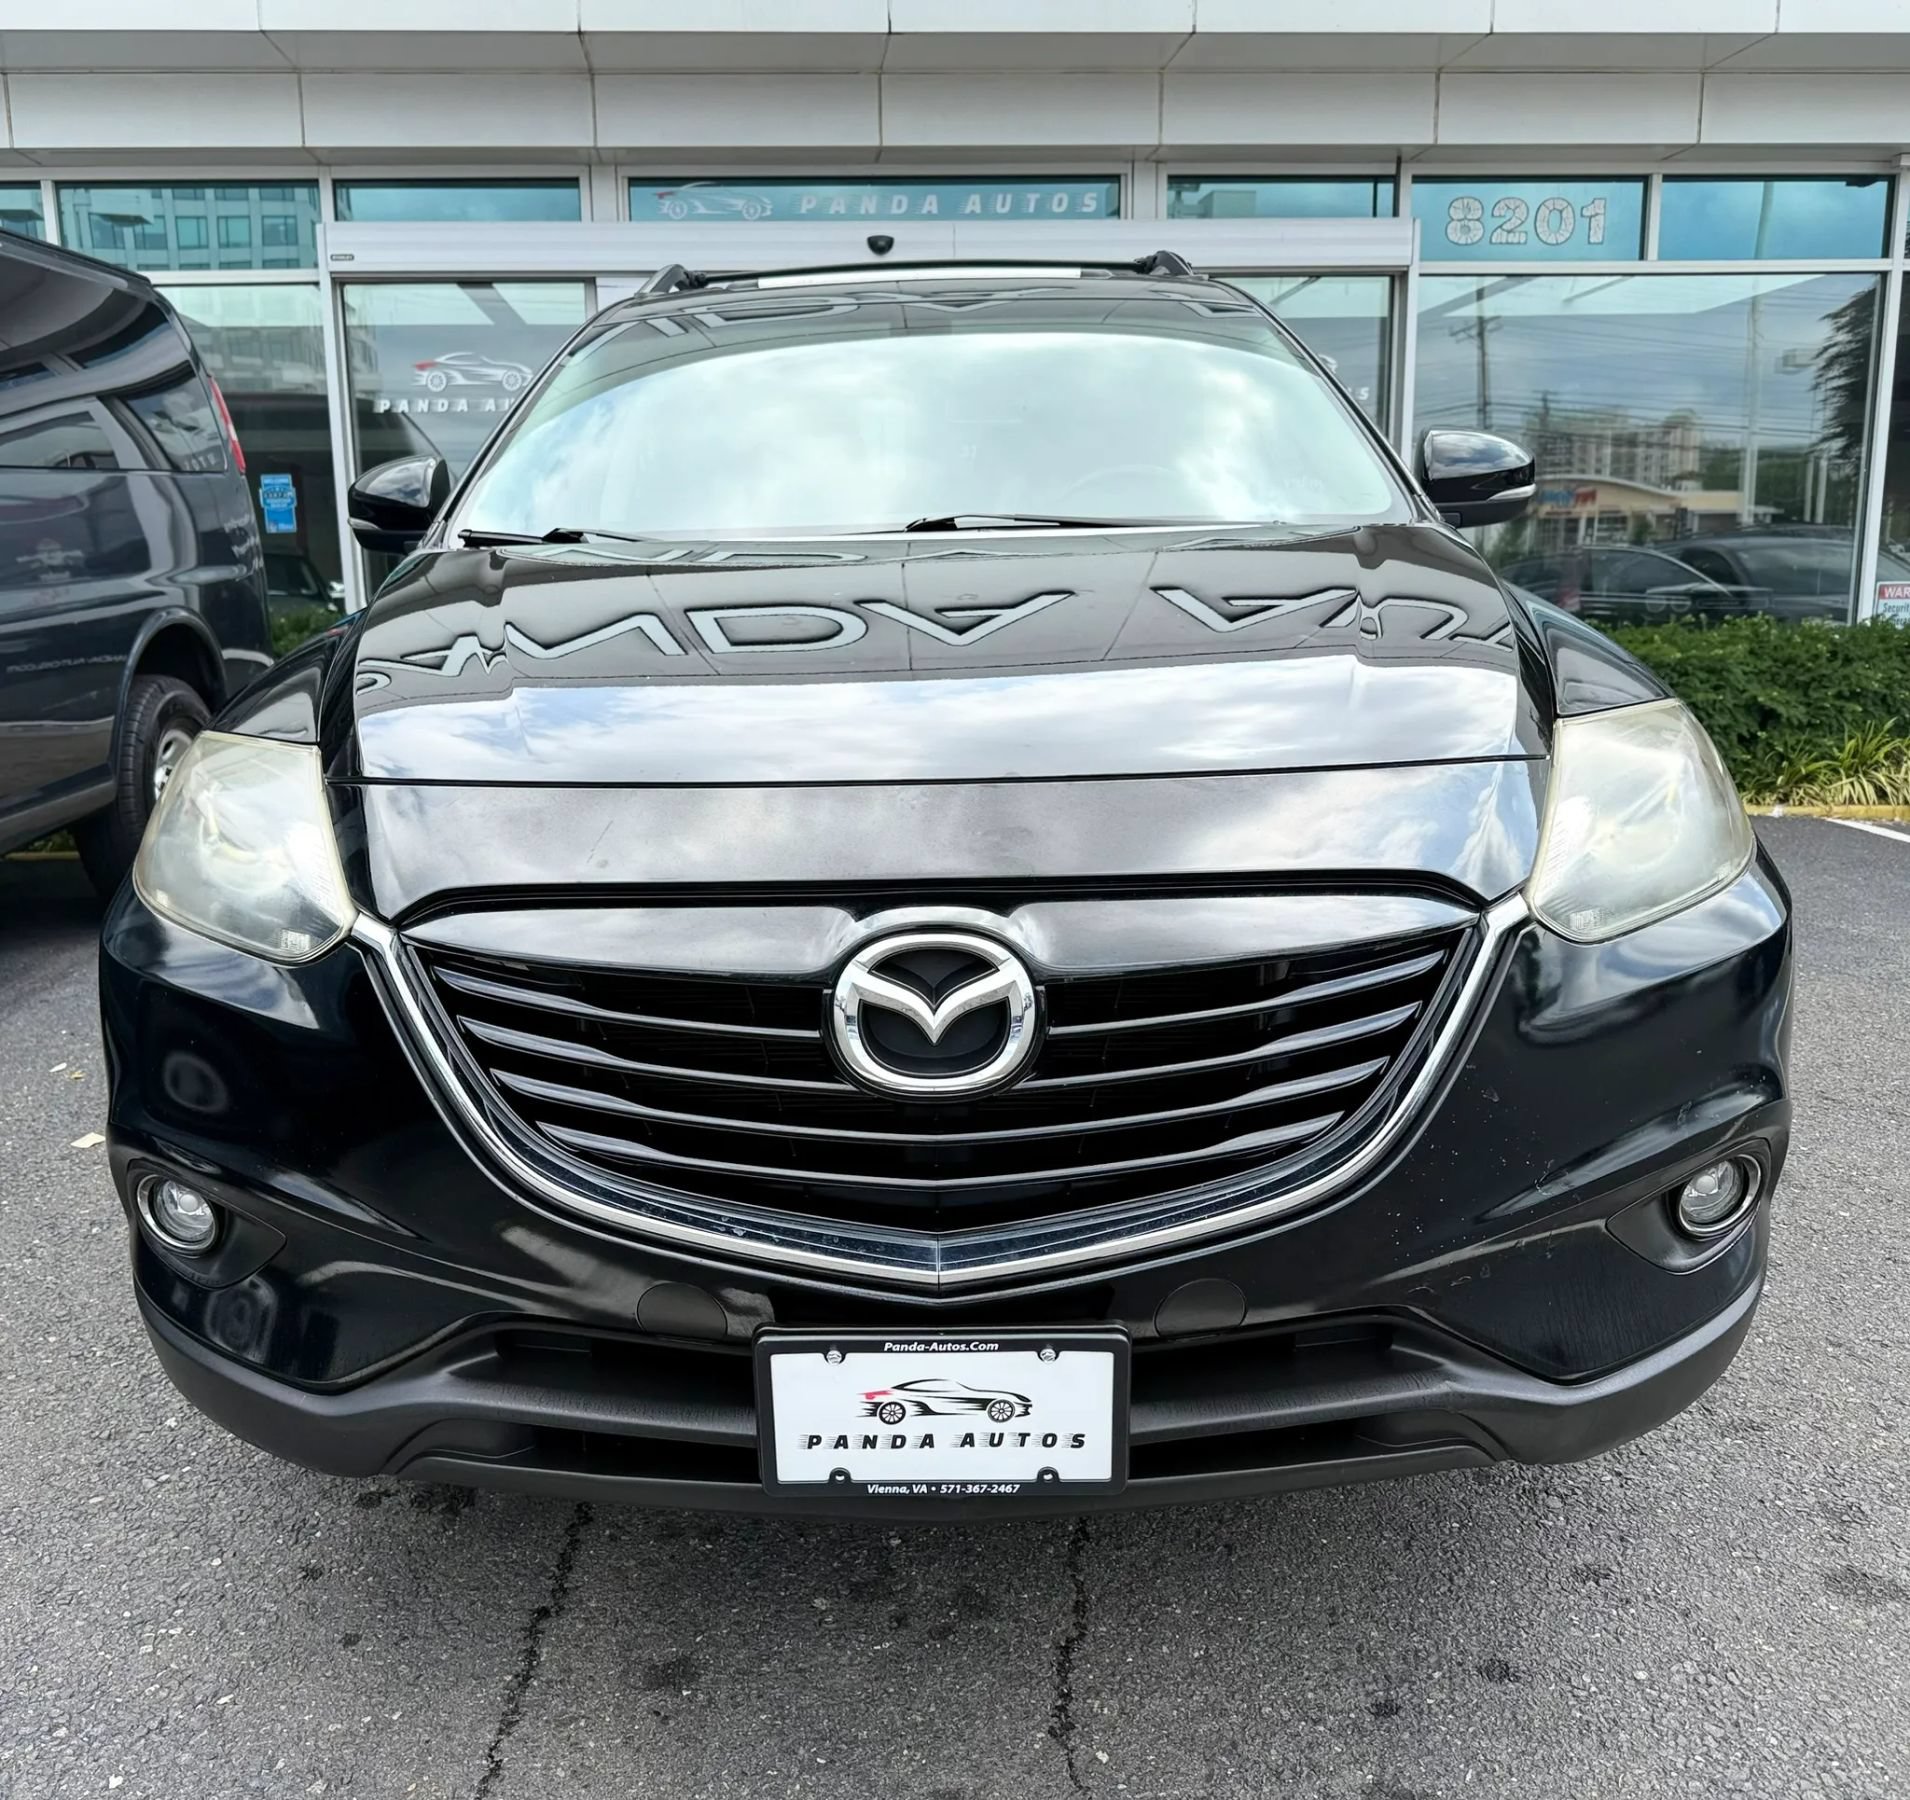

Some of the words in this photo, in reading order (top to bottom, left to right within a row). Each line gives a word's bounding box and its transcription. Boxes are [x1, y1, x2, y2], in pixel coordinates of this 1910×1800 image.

[797, 194, 939, 215] PANDA
[963, 192, 1099, 213] AUTOS
[1445, 196, 1607, 245] 8201
[376, 398, 468, 413] PANDA
[883, 1341, 999, 1352] Panda-Autos.Com
[799, 1433, 935, 1450] PANDA
[952, 1432, 1087, 1449] AUTOS
[867, 1484, 909, 1495] Vienna,
[912, 1484, 928, 1494] VA
[939, 1483, 1020, 1495] 571-367-2467
